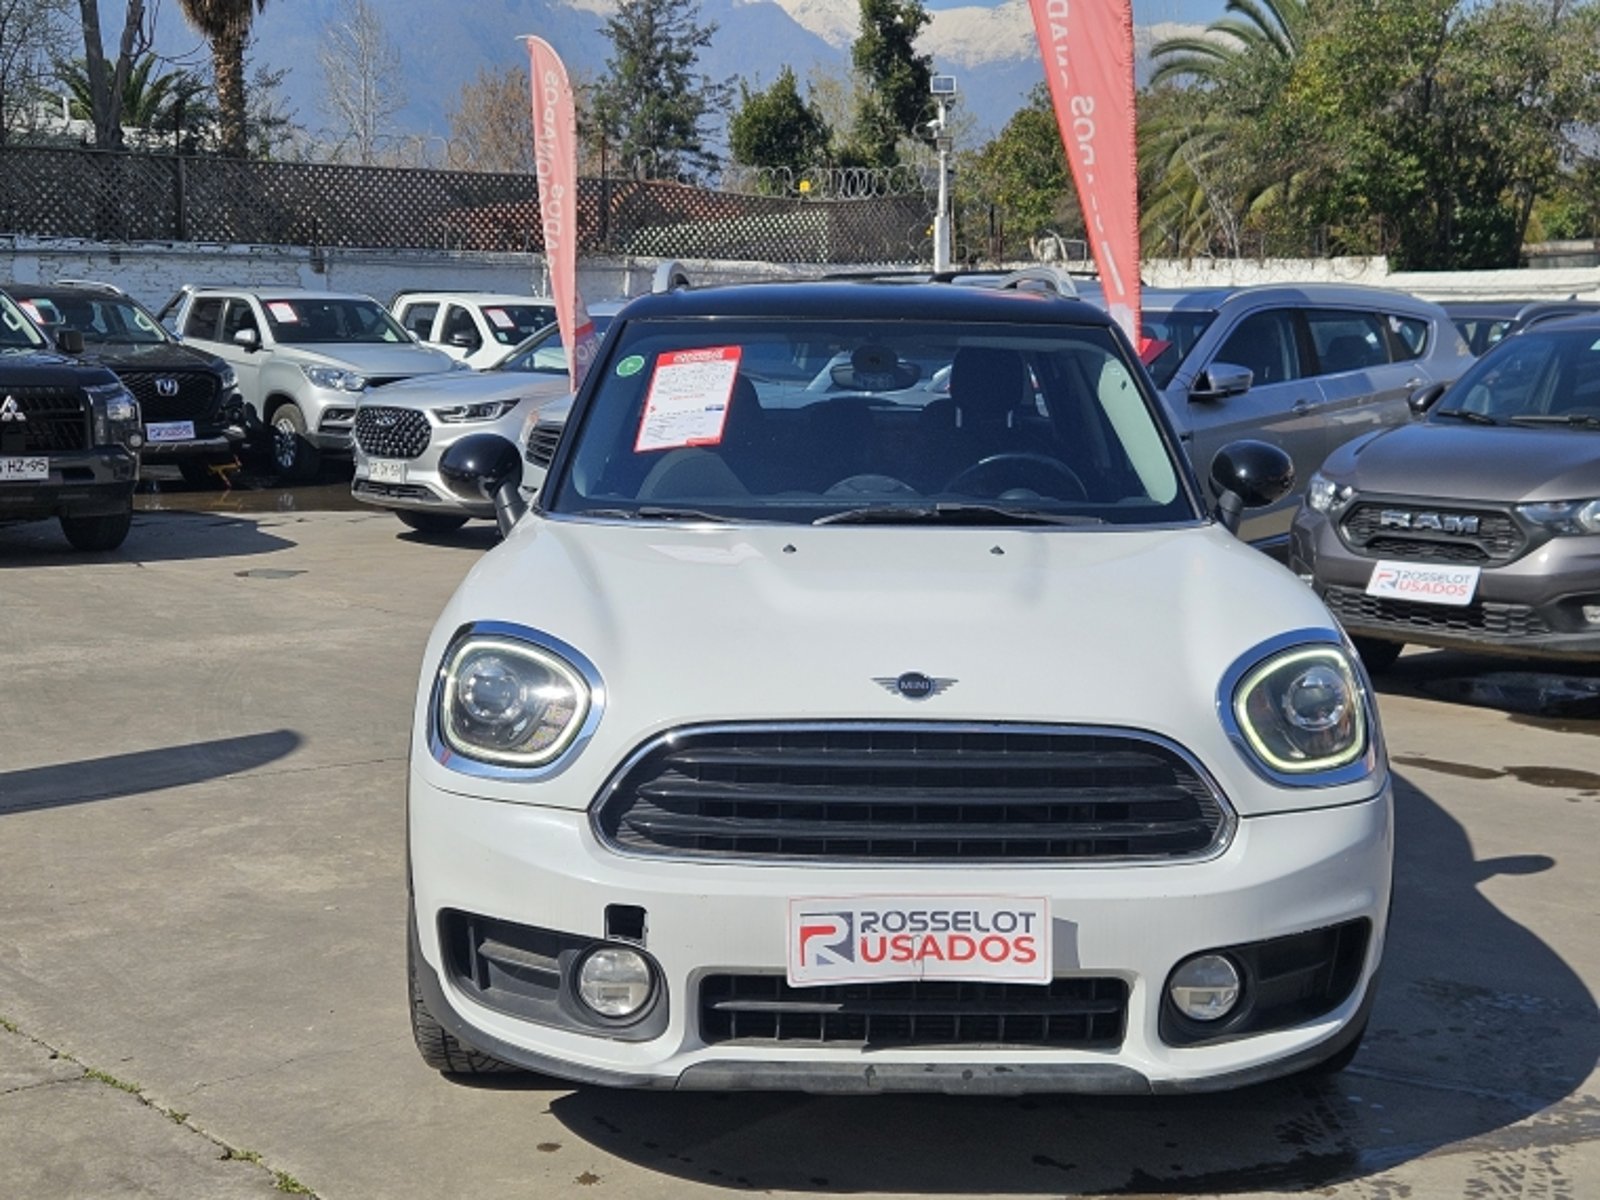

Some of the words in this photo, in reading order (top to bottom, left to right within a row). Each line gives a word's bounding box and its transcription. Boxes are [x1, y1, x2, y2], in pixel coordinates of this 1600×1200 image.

[1381, 510, 1479, 533] RAM
[1399, 569, 1472, 585] ROSSELOT
[1398, 580, 1468, 597] USADOS
[900, 681, 930, 690] MINI
[860, 911, 1037, 933] ROSSELOT
[860, 934, 1037, 964] USADOS
